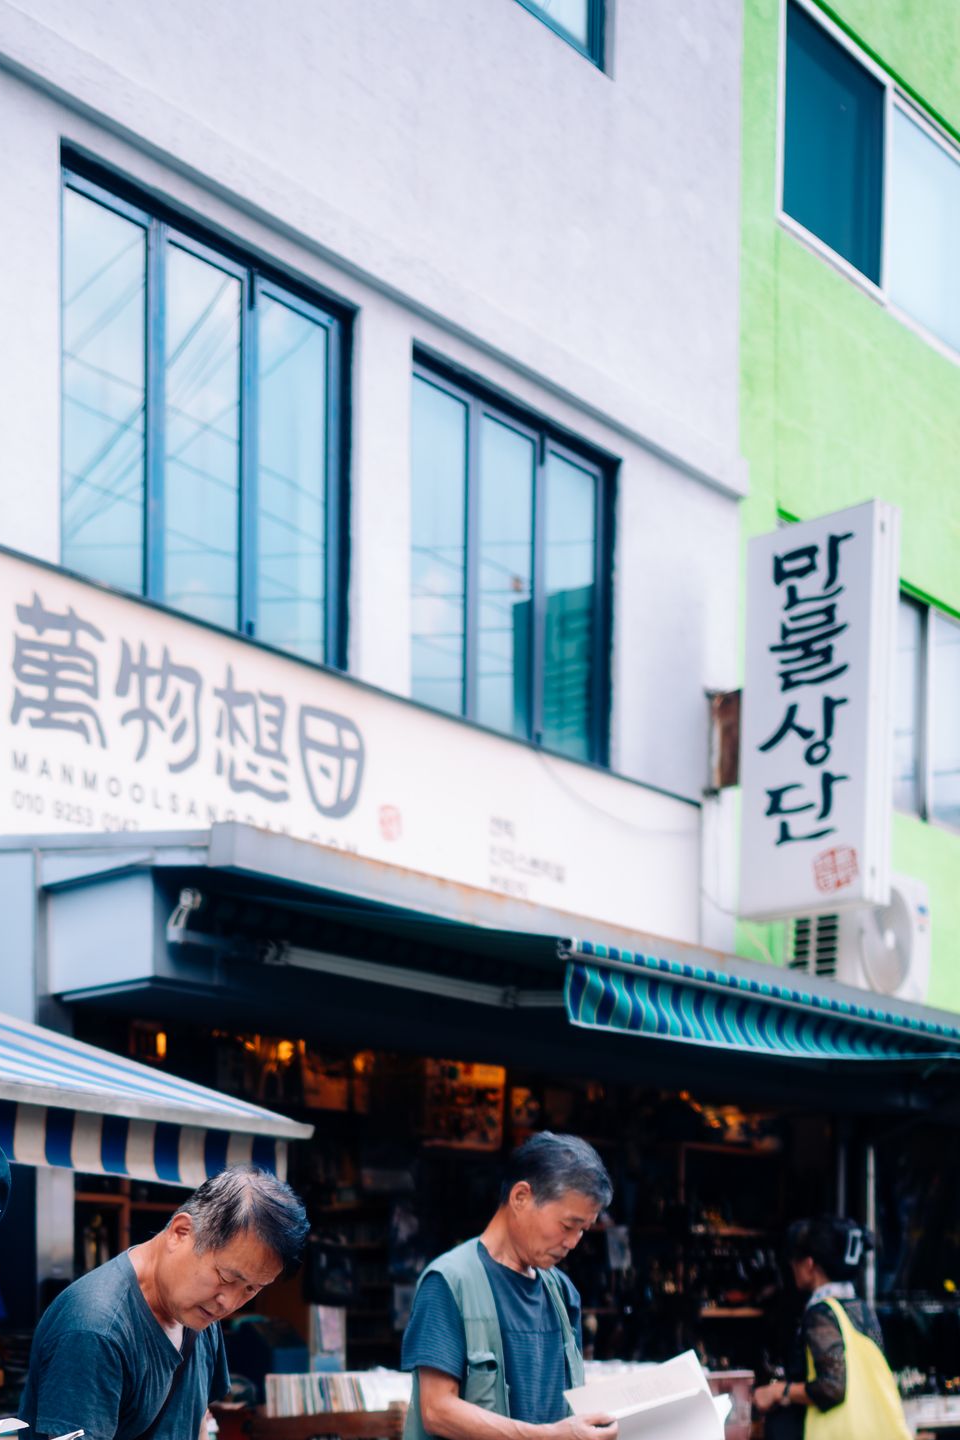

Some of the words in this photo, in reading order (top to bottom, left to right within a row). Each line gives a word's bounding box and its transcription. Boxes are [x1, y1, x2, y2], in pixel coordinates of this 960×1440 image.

[758, 532, 856, 846] 만물상단
[12, 789, 43, 814] 010
[52, 799, 95, 828] 9253
